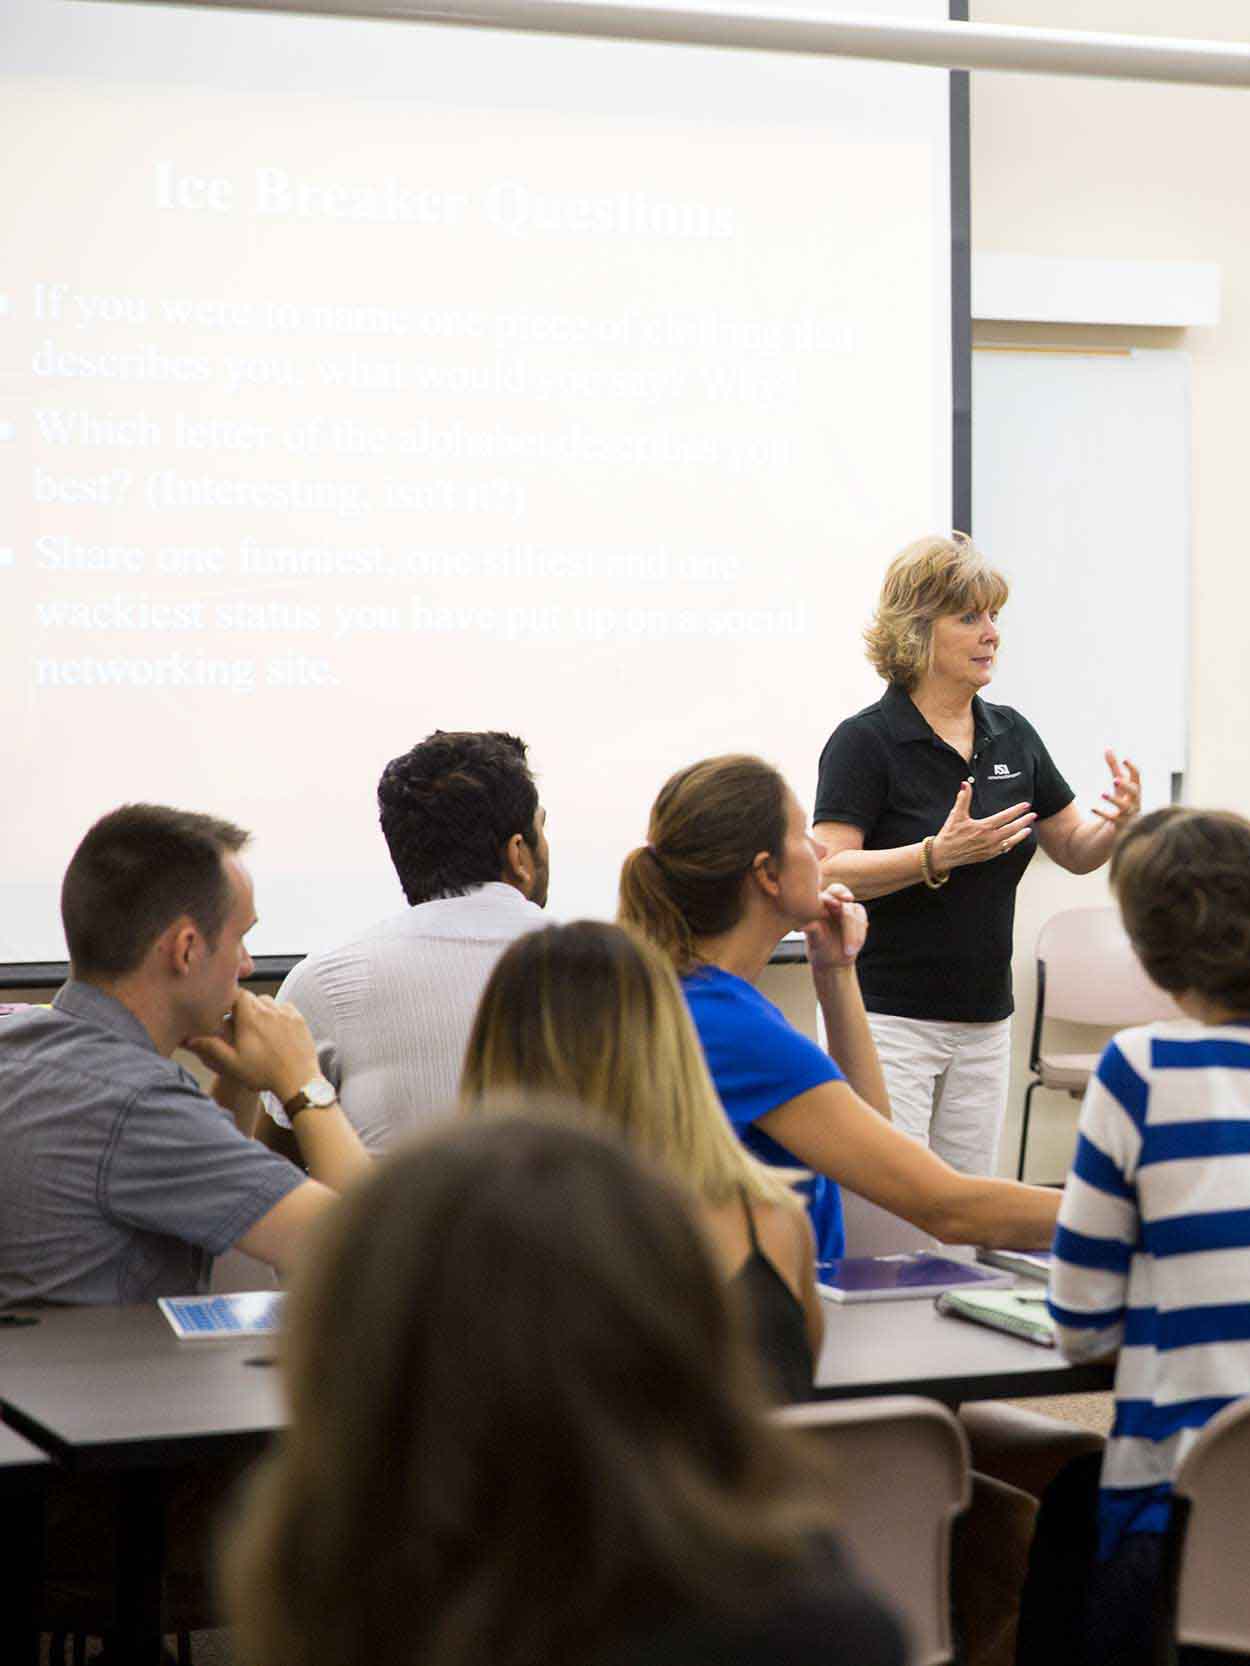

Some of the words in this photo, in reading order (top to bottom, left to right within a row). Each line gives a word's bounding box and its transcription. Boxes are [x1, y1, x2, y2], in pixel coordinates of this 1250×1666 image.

[153, 161, 233, 211] Ice
[255, 167, 468, 224] Breaker
[486, 181, 738, 242] Questions
[33, 281, 70, 321] If
[74, 296, 146, 329] you
[160, 299, 252, 329] were
[266, 303, 302, 330] to
[312, 304, 408, 335] name
[419, 309, 488, 337] one
[495, 311, 588, 349] piece
[599, 305, 643, 345] of
[32, 337, 210, 379] describes
[317, 351, 402, 387] what
[418, 357, 526, 394] would
[34, 406, 161, 449] Which
[175, 410, 273, 450] letter
[287, 414, 324, 454] of
[332, 417, 386, 456] the
[399, 417, 549, 466] alphabet
[33, 464, 134, 504] best?
[384, 475, 457, 511] isn't
[35, 535, 145, 574] Share
[157, 544, 226, 575] one
[406, 548, 476, 577] one
[480, 542, 595, 577] silliest
[606, 543, 668, 579] and
[677, 552, 742, 583] one
[34, 592, 208, 631] wackiest
[215, 598, 322, 631] status
[333, 604, 402, 640] you
[410, 595, 498, 633] have
[505, 603, 562, 641] put
[572, 606, 619, 641] up
[625, 609, 668, 635] on
[676, 609, 700, 634] a
[704, 599, 806, 637] social
[33, 648, 257, 696] networking
[264, 650, 343, 688] site.
